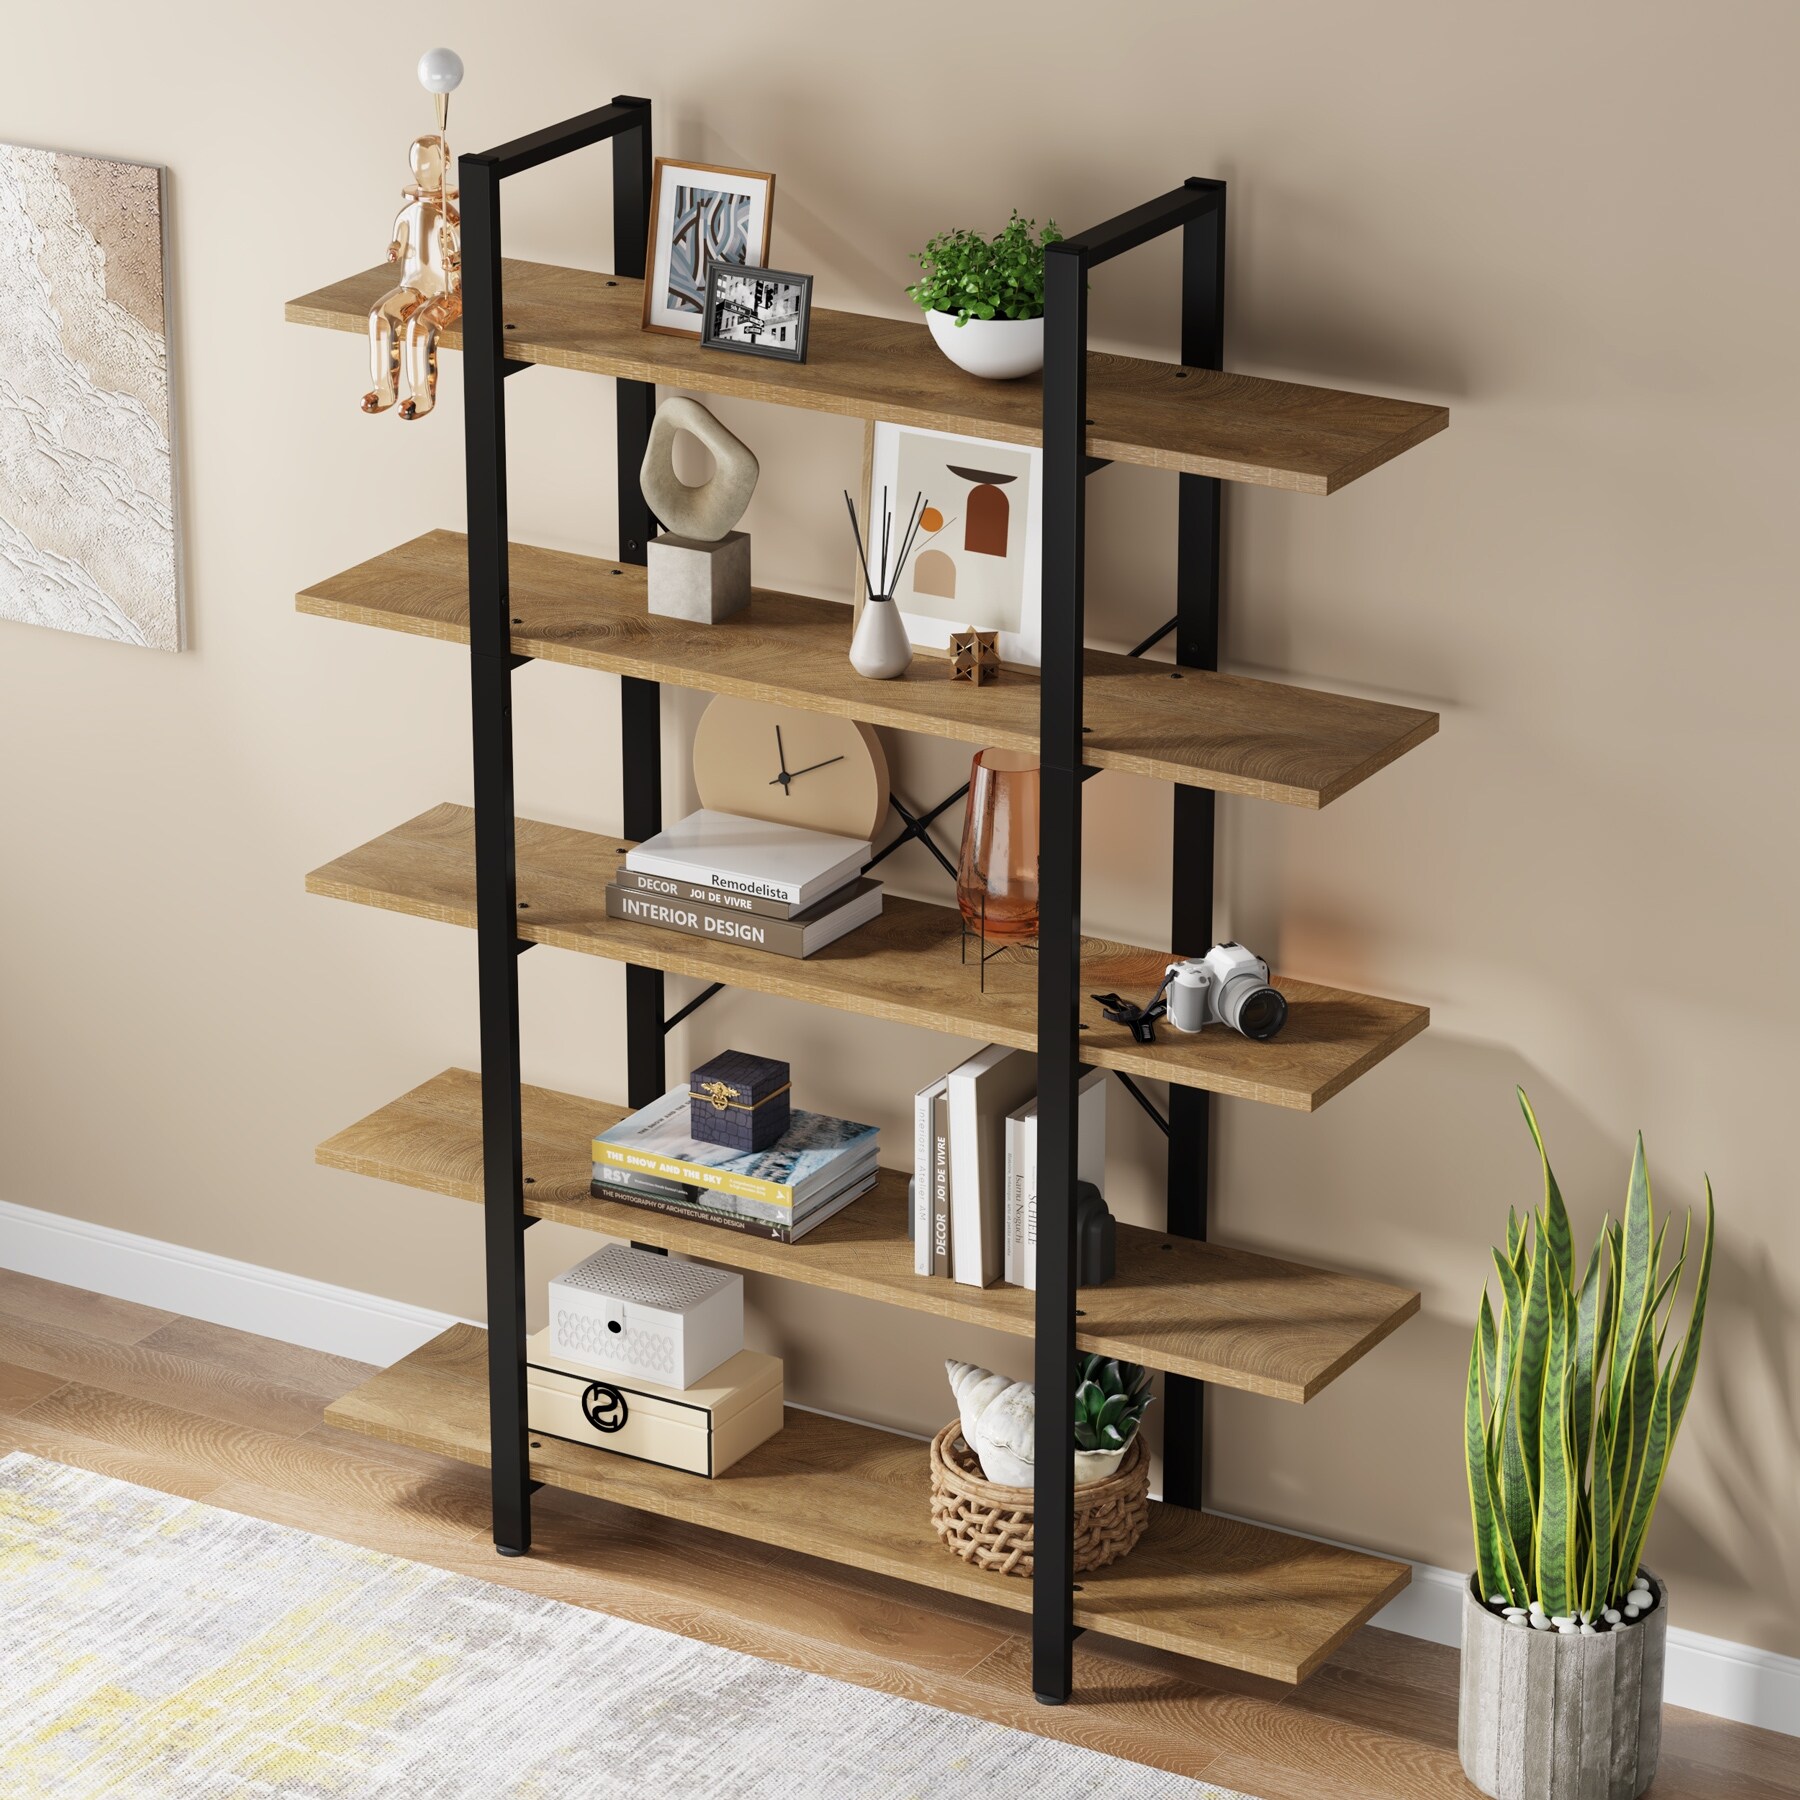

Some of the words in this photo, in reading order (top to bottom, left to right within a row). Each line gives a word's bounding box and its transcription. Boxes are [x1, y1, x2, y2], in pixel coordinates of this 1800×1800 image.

[637, 876, 678, 895] DECOR
[690, 888, 705, 900] JOI
[708, 892, 721, 902] DE
[723, 895, 752, 910] VIVRE
[711, 874, 788, 900] Remodelista
[622, 897, 698, 929] INTERIOR
[704, 916, 764, 944] DESIGN
[606, 1150, 624, 1162] THE
[626, 1155, 657, 1169] SNOW
[659, 1163, 680, 1175] AND
[683, 1168, 700, 1180] THE
[703, 1173, 723, 1185] SKY
[938, 1136, 946, 1165] VIVRE
[603, 1167, 631, 1184] RSY
[919, 1165, 927, 1200] Atelier
[937, 1168, 946, 1184] DE
[1015, 1174, 1024, 1202] Isamu
[602, 1189, 614, 1198] THE
[615, 1192, 657, 1208] PHOTOGRAPHY
[657, 1202, 666, 1210] OF
[666, 1204, 709, 1220] ARCHITECTURE
[709, 1215, 723, 1224] AND
[723, 1219, 745, 1229] DESIGN
[937, 1185, 946, 1202] JOI
[936, 1213, 946, 1256] DECOR
[1014, 1203, 1024, 1244] Noguchi
[1028, 1194, 1037, 1245] SCHIELE
